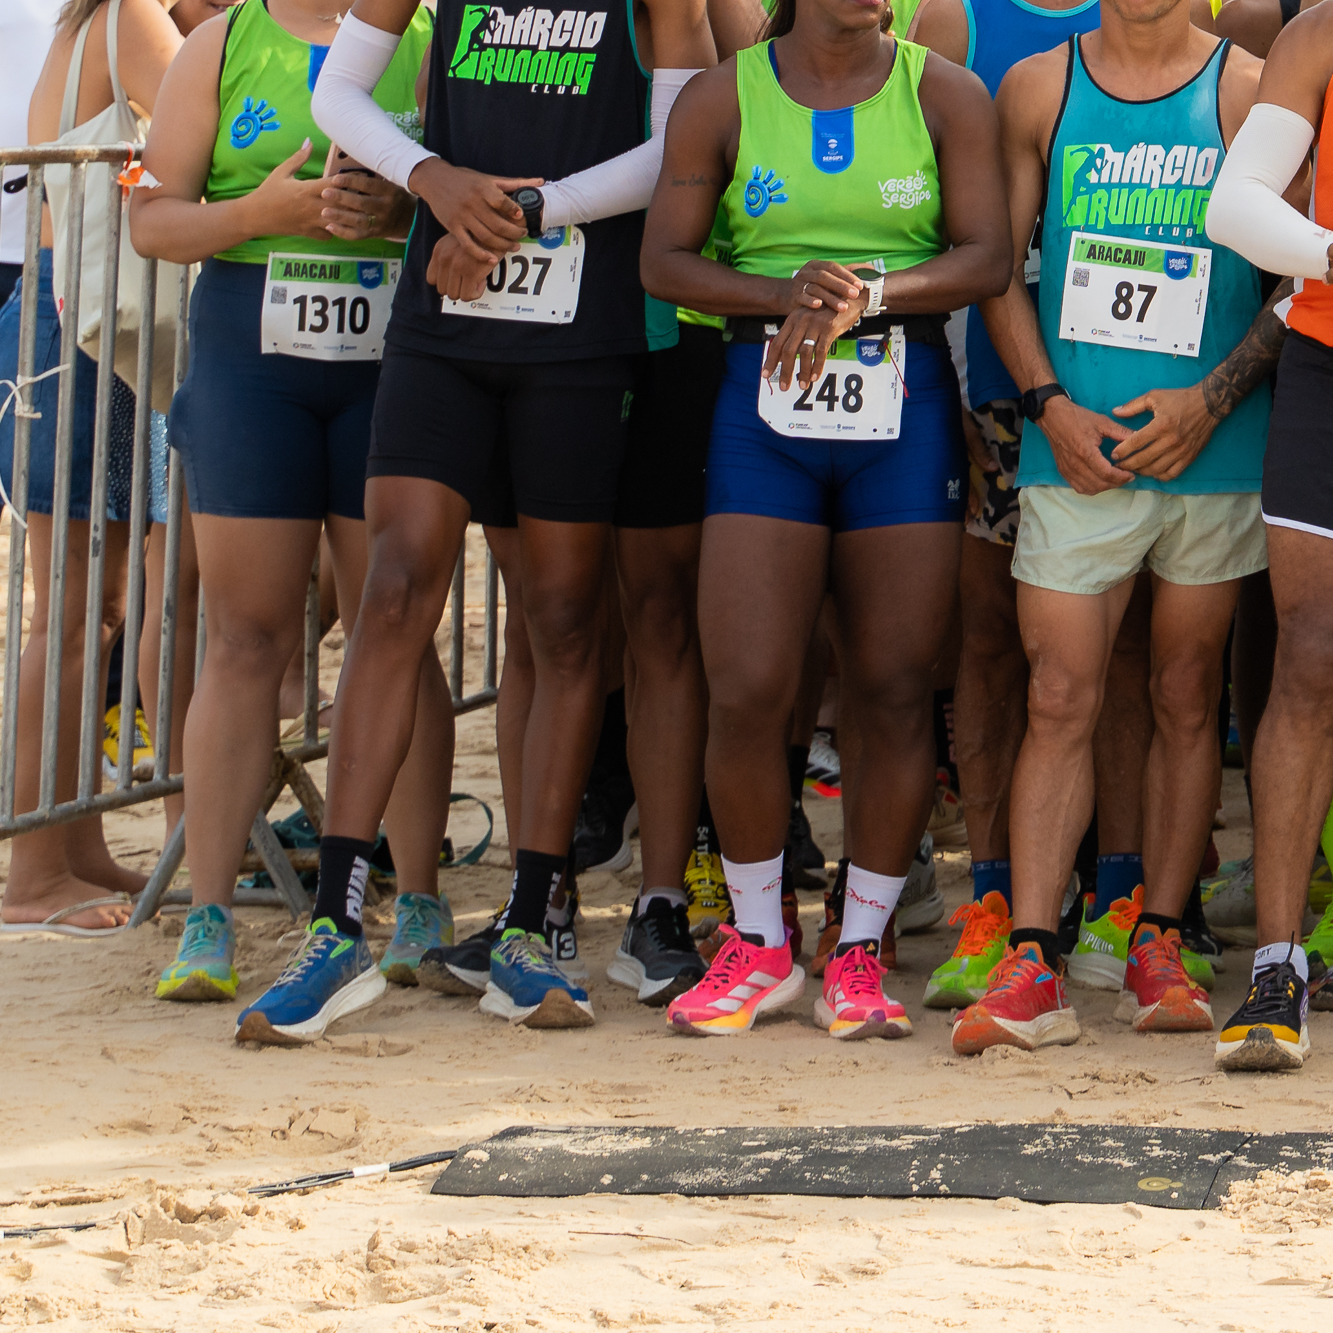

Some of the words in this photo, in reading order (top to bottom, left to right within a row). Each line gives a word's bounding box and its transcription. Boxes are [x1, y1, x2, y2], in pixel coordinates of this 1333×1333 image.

[483, 6, 607, 50] MÁRCIO
[476, 47, 597, 94] RUNNING
[531, 83, 580, 94] CLUB
[1090, 141, 1219, 188] MÁRCIO
[882, 190, 932, 209] Sergipe
[1088, 186, 1212, 234] RUNNING
[1145, 226, 1193, 238] CLUB
[283, 261, 341, 280] ARACAJU
[486, 255, 553, 296] 027
[1086, 244, 1146, 266] ARACAJU
[292, 294, 371, 335] 1310
[1111, 280, 1158, 323] 87
[793, 372, 864, 414] 248
